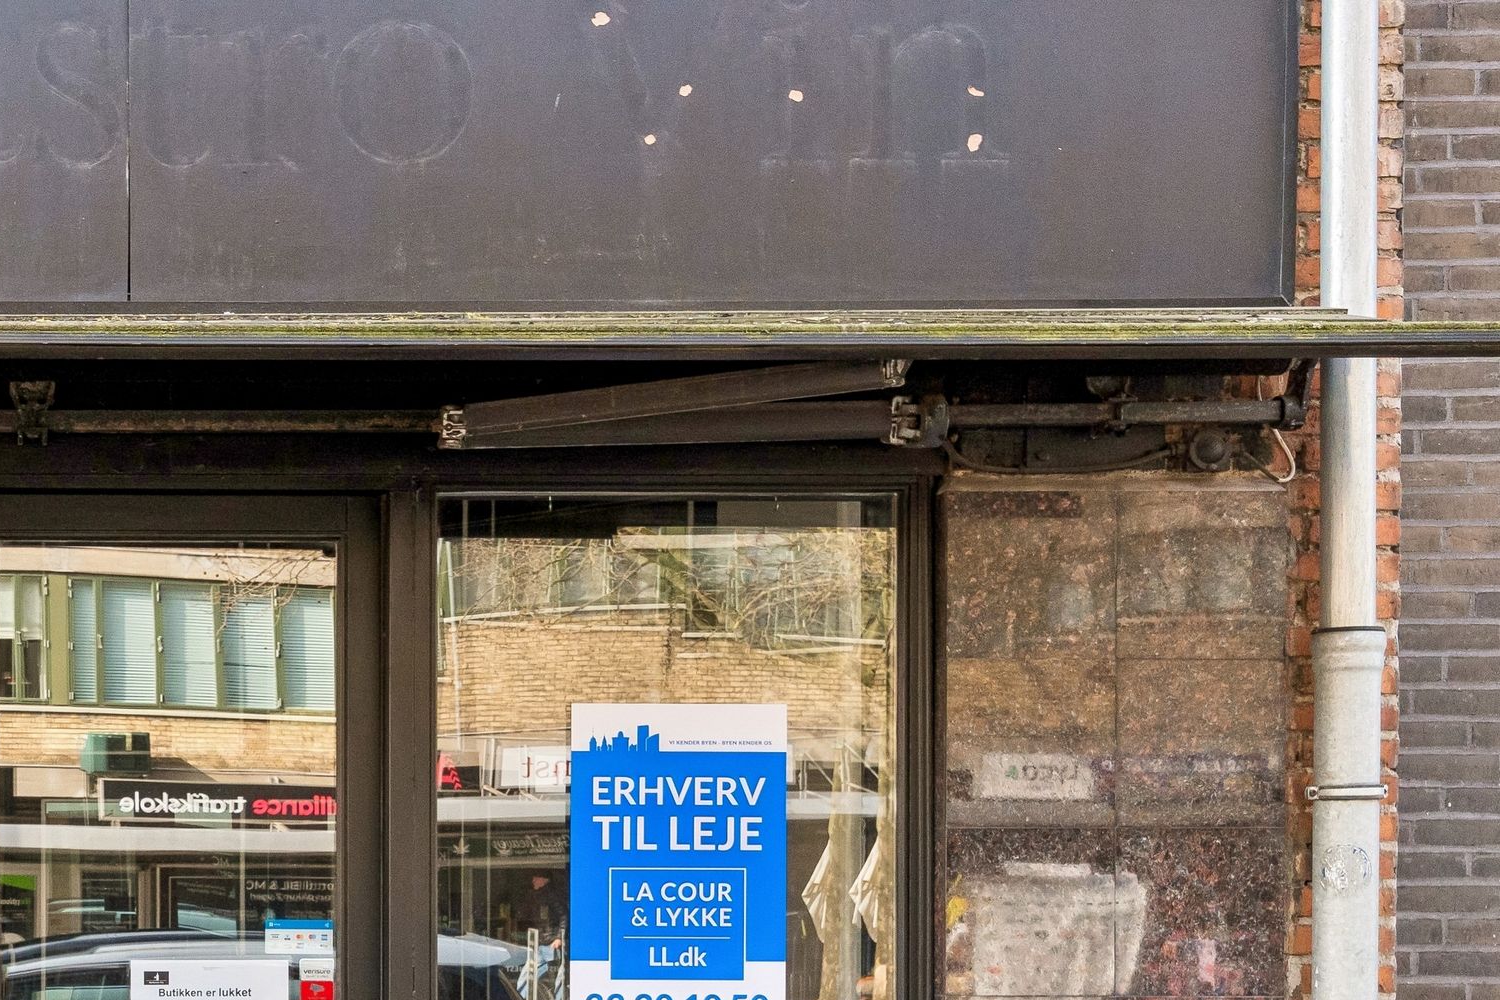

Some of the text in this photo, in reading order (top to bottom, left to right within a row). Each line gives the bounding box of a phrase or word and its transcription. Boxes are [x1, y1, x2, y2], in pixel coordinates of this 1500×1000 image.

[592, 776, 766, 806] ERHVERV
[592, 816, 763, 852] TIL LEJE
[622, 882, 733, 902] LA COUR
[631, 907, 733, 927] & LYKKE
[649, 945, 707, 968] LL.dk
[303, 968, 331, 976] verisure
[158, 988, 203, 997] Butikken
[218, 988, 252, 997] lukket
